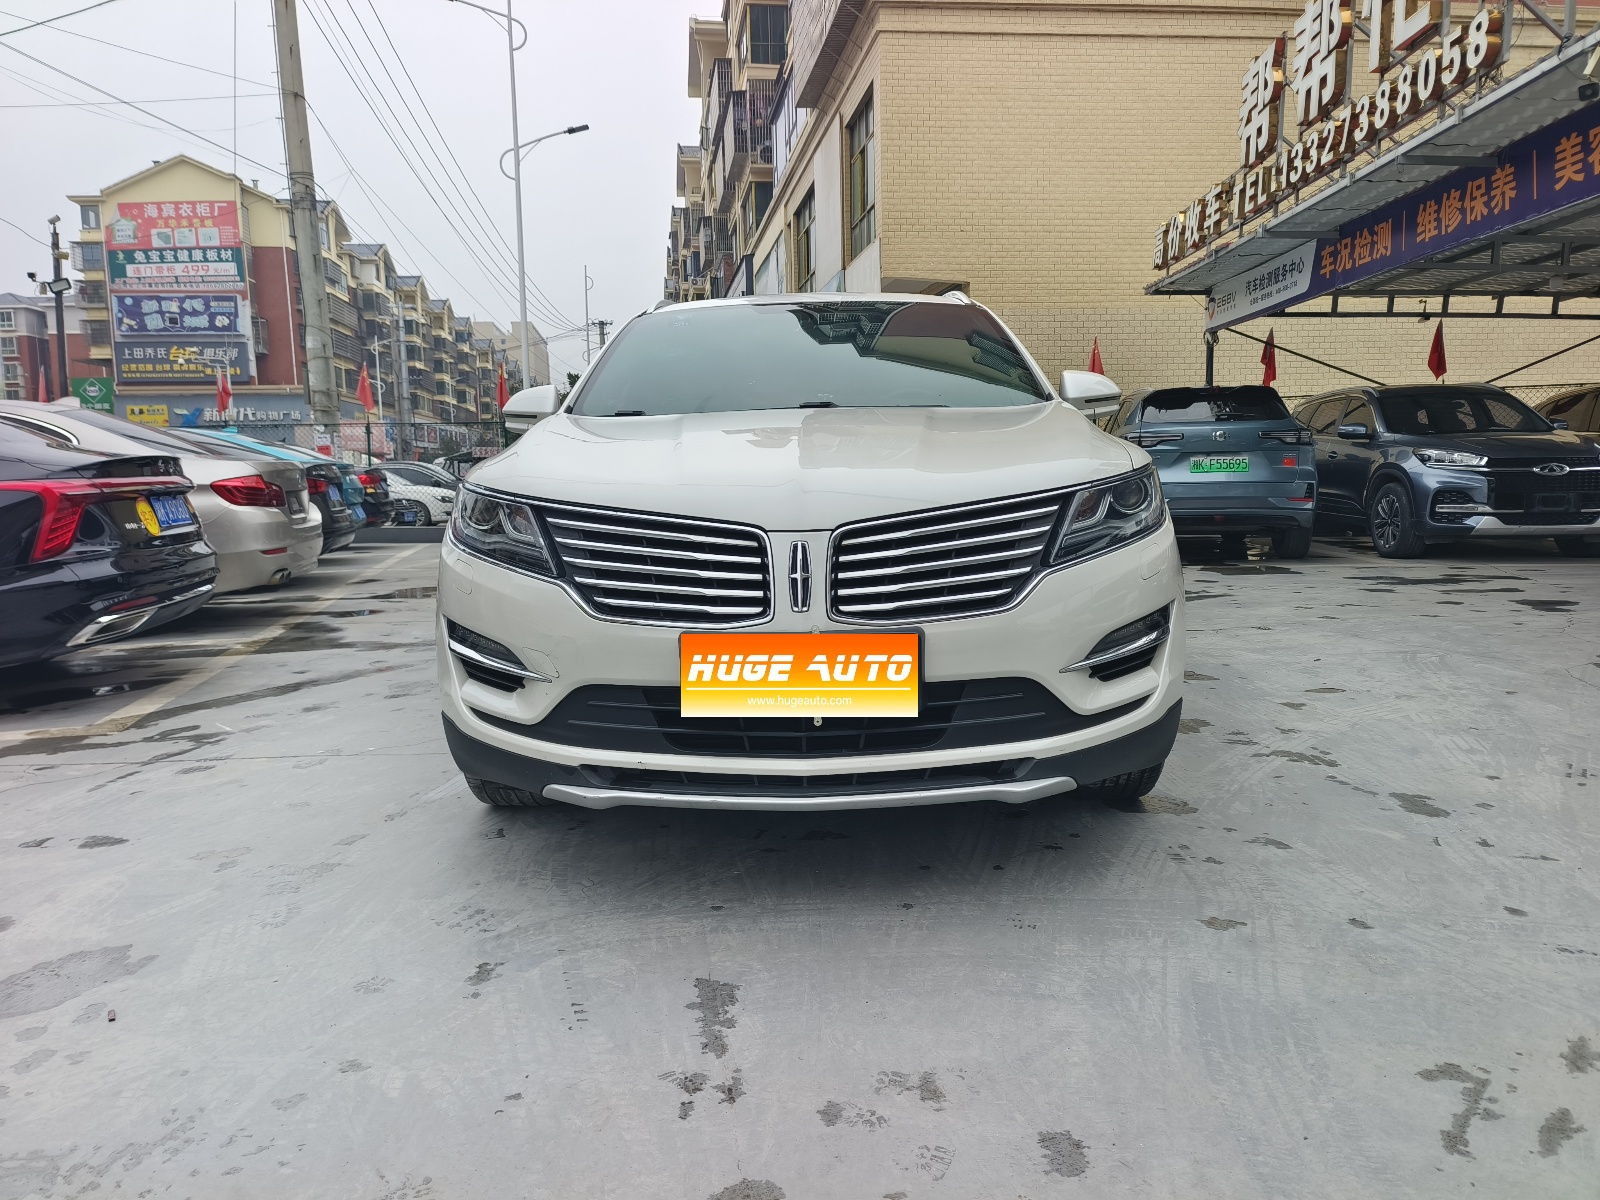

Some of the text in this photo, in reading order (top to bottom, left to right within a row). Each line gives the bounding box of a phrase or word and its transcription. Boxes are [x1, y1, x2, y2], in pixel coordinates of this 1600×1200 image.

[1153, 183, 1222, 268] 高价收车
[1320, 219, 1392, 278] 车况检测
[1416, 163, 1518, 243] 维修保养
[134, 249, 233, 263] 兔宝宝健康板材
[182, 265, 210, 275] 499
[1245, 256, 1305, 297] 汽车检测服务中心
